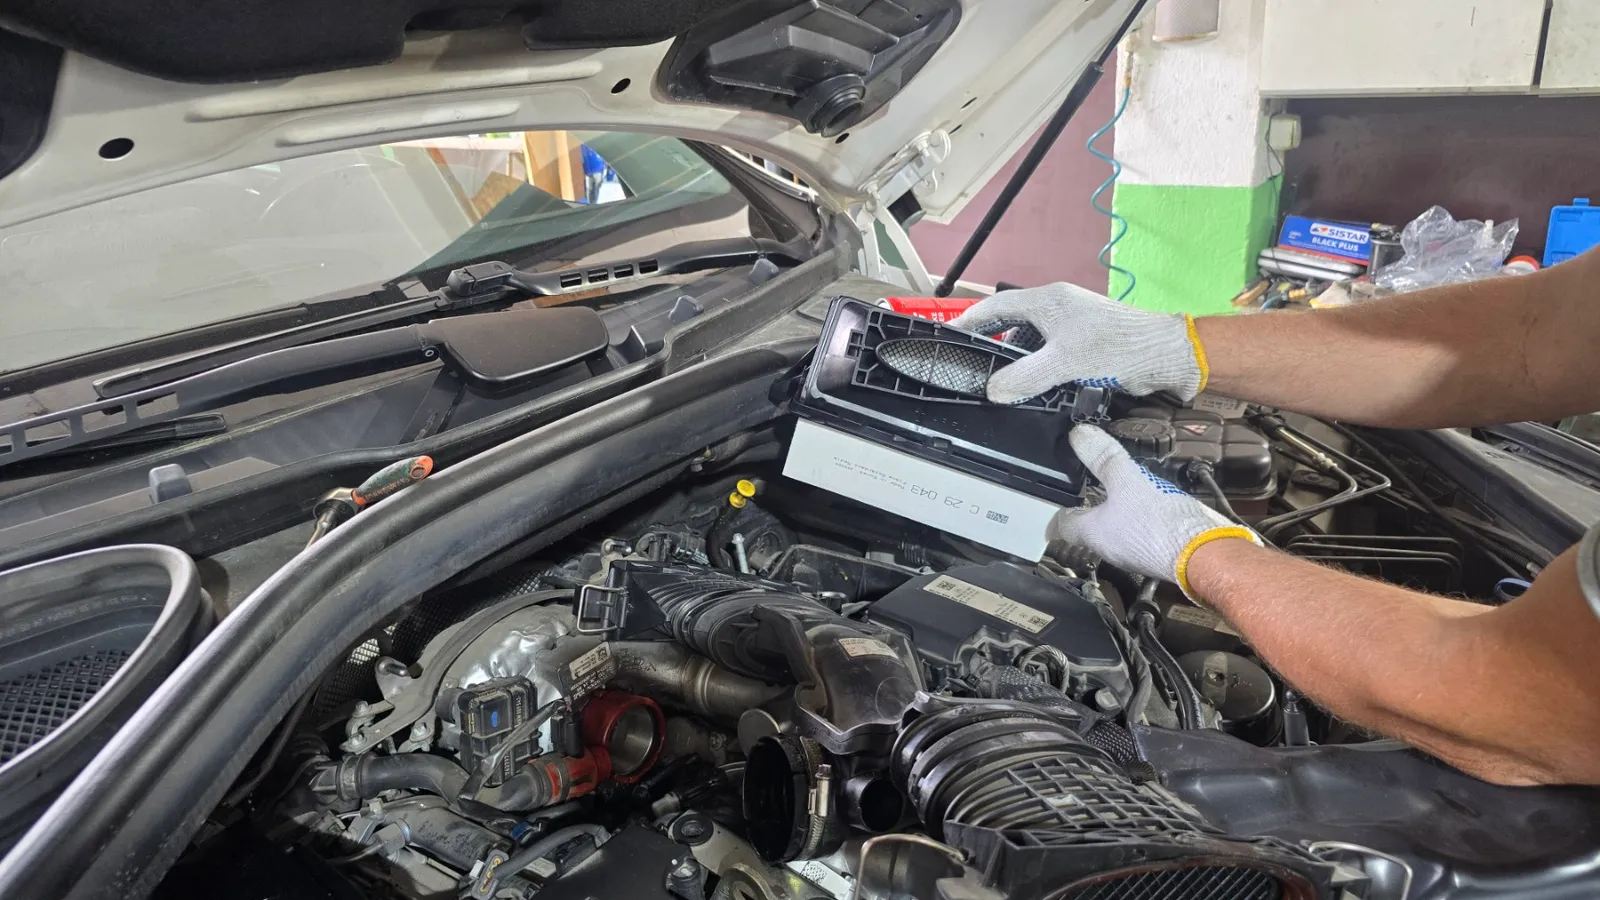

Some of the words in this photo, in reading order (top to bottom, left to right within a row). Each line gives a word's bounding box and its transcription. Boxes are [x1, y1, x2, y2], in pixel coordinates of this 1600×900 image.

[1328, 227, 1367, 243] SISTAR
[1311, 236, 1337, 248] BLACK
[1338, 241, 1359, 252] PLUS
[910, 484, 938, 501] 043
[943, 496, 963, 509] 29
[968, 504, 980, 515] C
